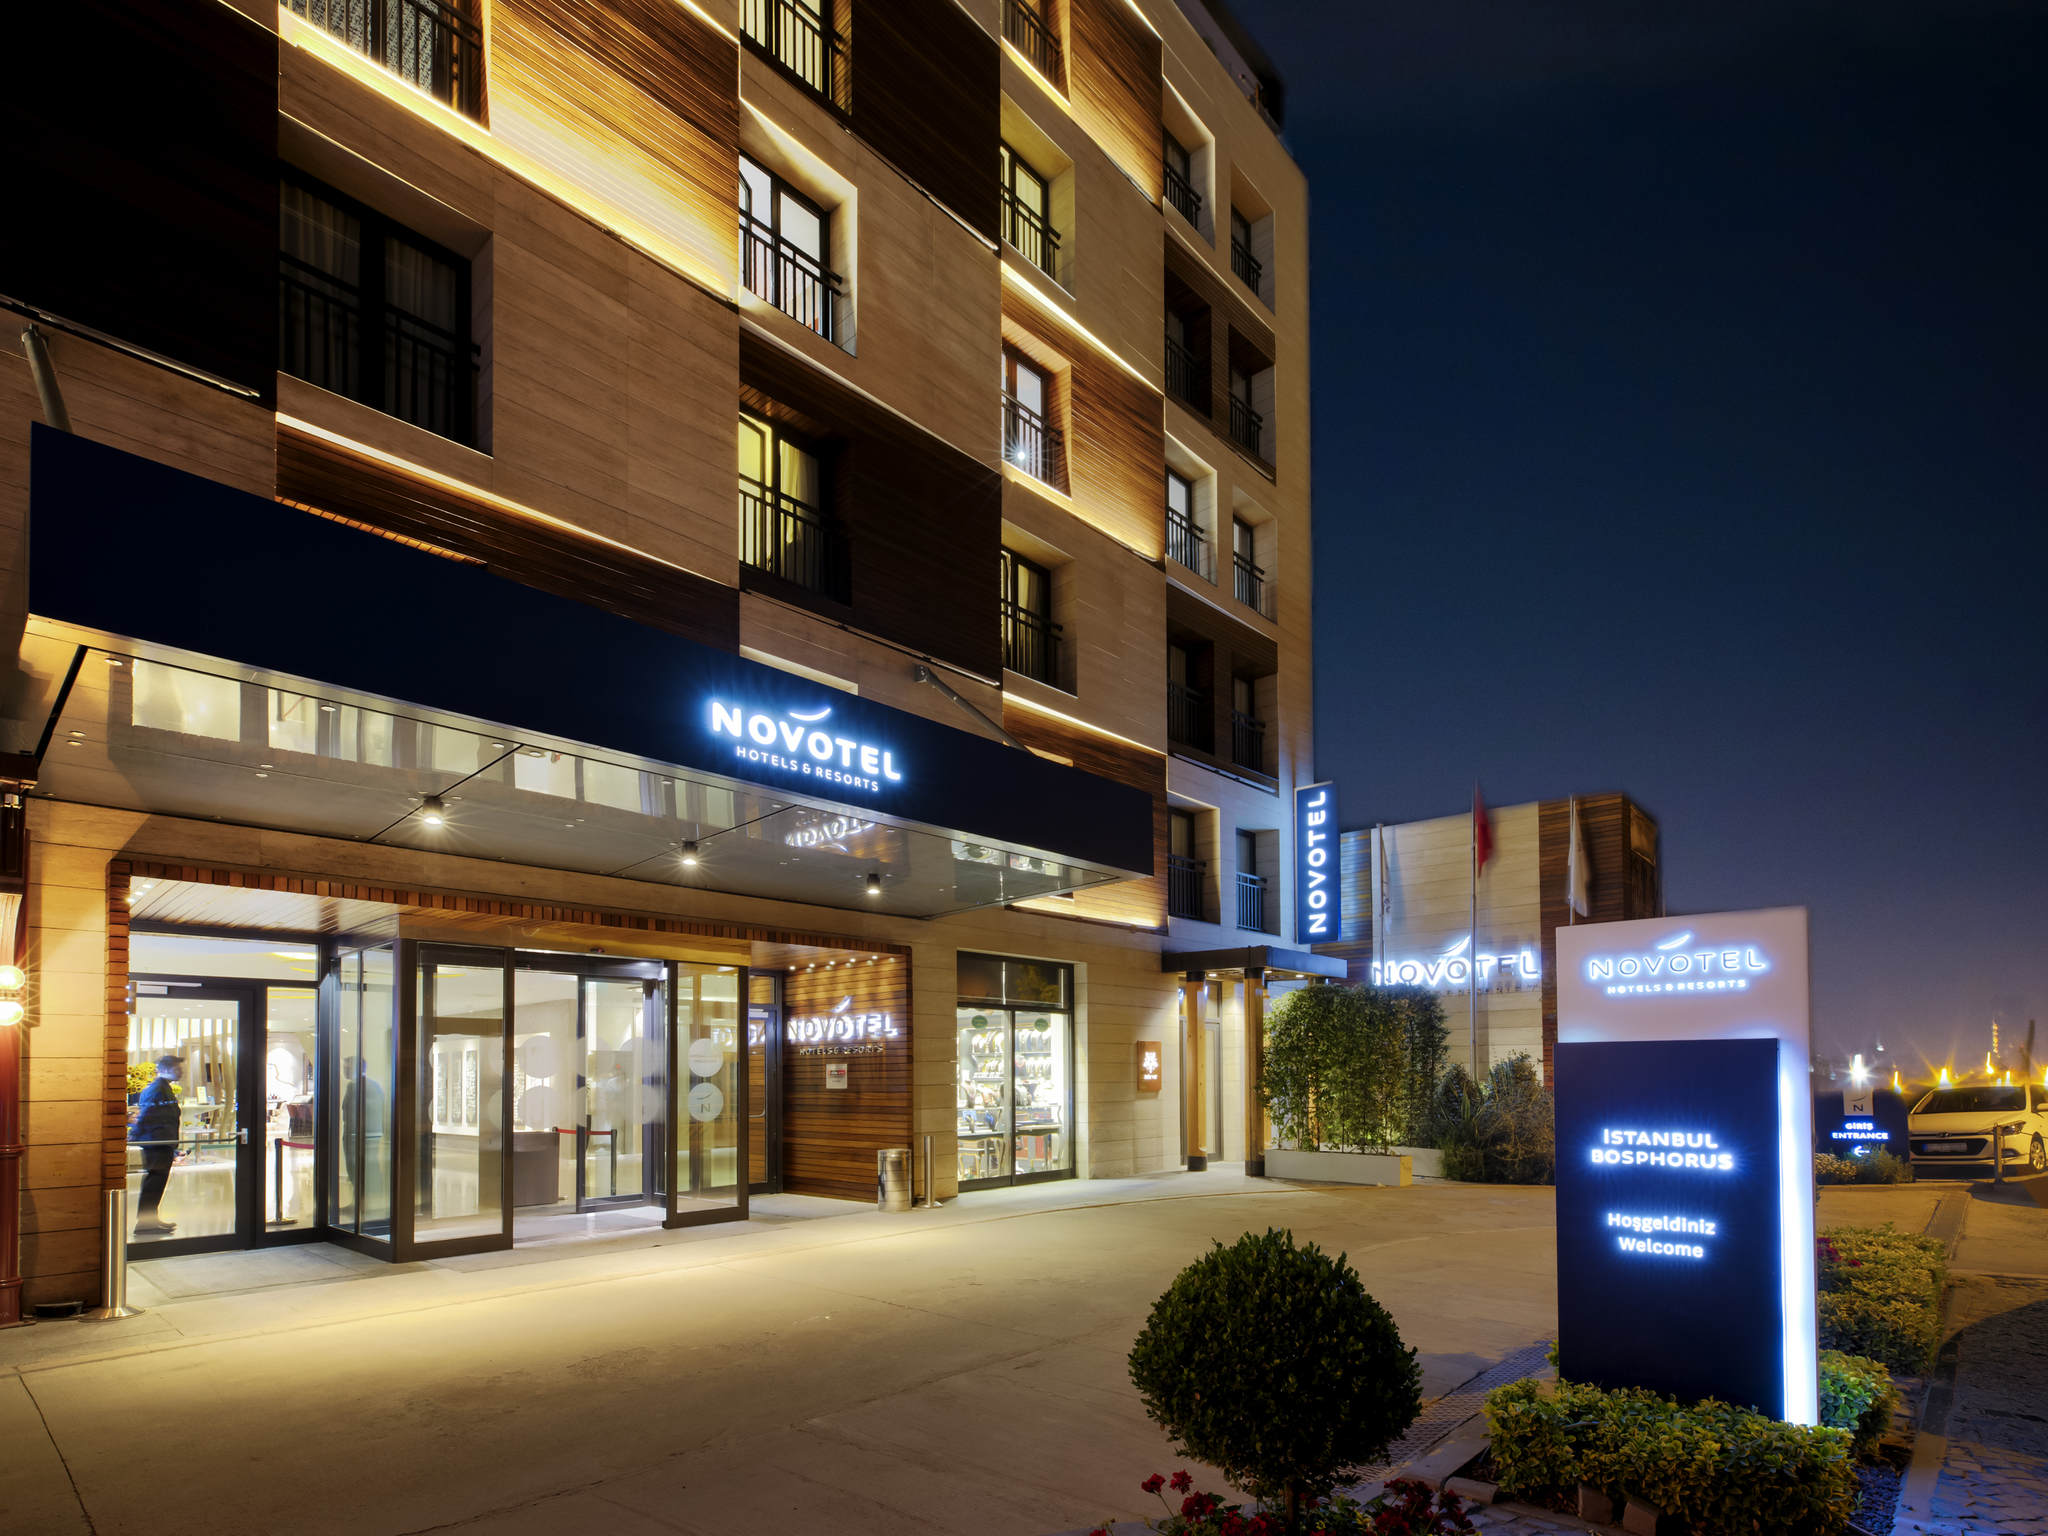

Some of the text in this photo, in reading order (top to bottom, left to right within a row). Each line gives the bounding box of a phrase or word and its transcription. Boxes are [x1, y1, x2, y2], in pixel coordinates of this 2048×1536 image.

[711, 701, 902, 781] NOVOTEL
[736, 745, 880, 792] HOTELS & RESORTS
[1307, 790, 1328, 934] NOVOTEL
[1372, 950, 1541, 987] NOVOTEL
[1589, 948, 1766, 980] NOVOTEL
[1607, 983, 1662, 995] HOTELS
[1677, 979, 1747, 992] RESORTS
[787, 1014, 899, 1042] NOVOTEL
[1831, 1132, 1889, 1140] ENTRANCE
[1591, 1148, 1734, 1170] BOSPHORUS
[1618, 1236, 1704, 1259] Welcome
